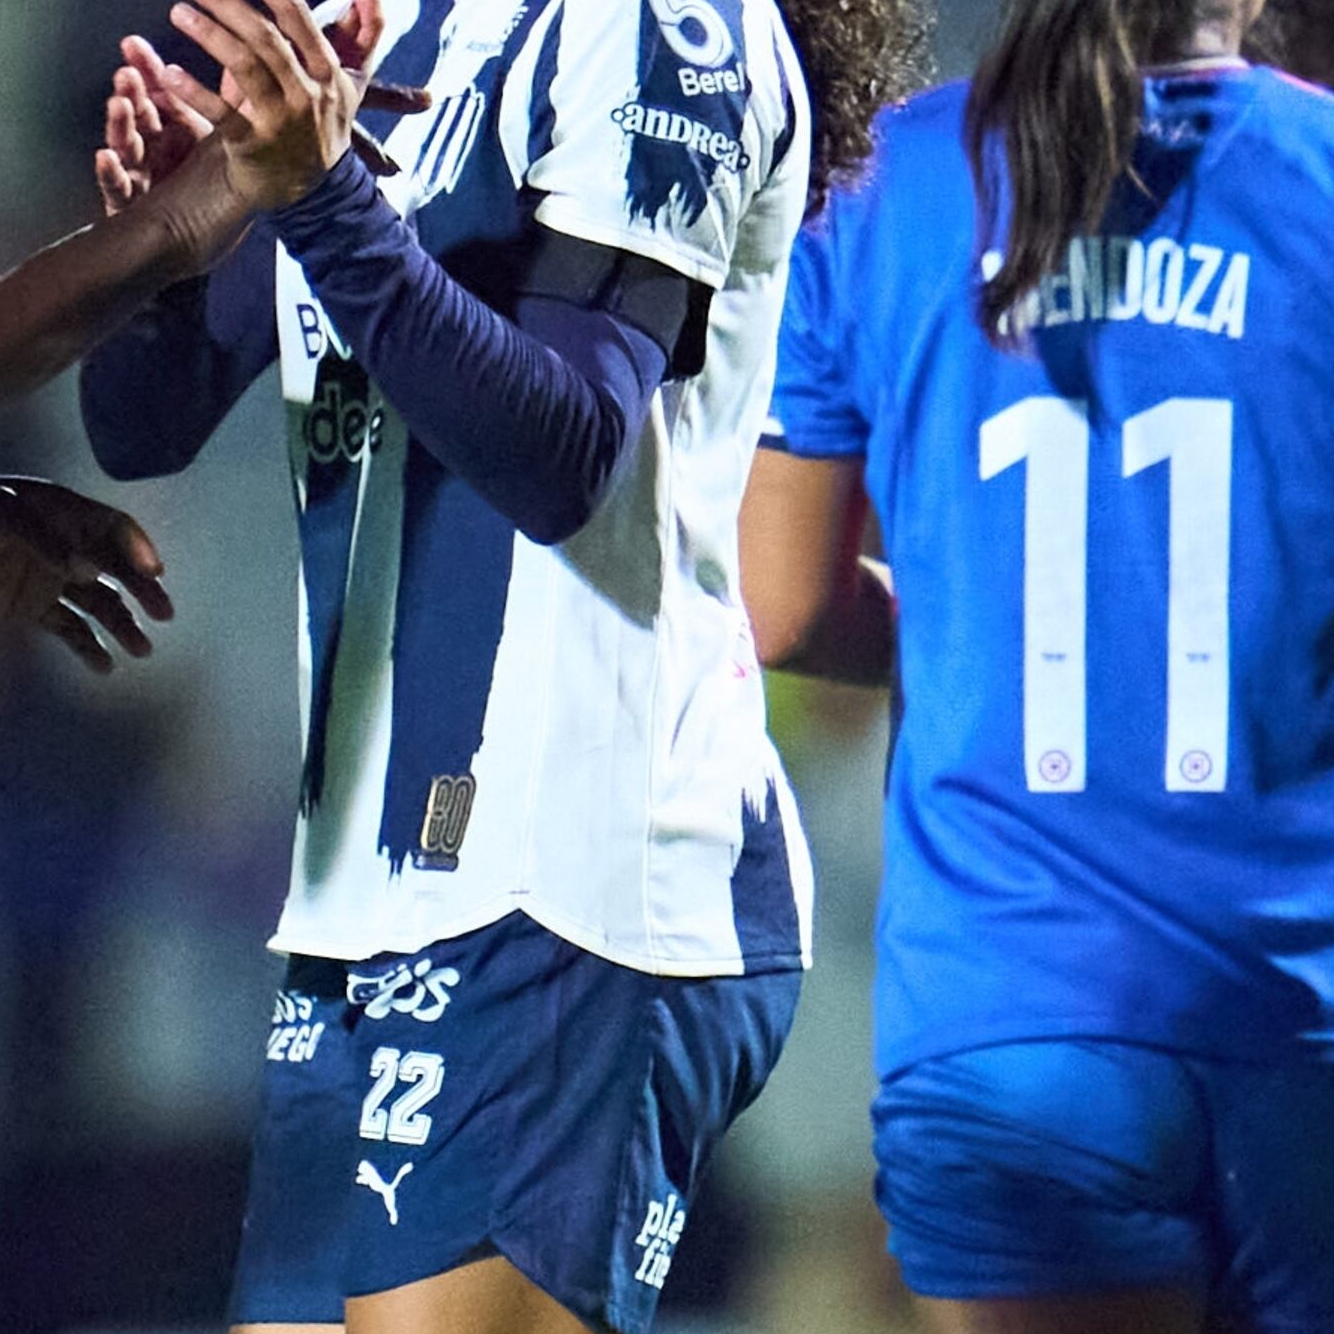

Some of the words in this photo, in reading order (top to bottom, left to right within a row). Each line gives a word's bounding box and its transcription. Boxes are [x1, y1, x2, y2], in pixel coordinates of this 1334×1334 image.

[678, 62, 746, 97] Berel
[979, 395, 1233, 793] 11
[359, 1046, 445, 1146] 22
